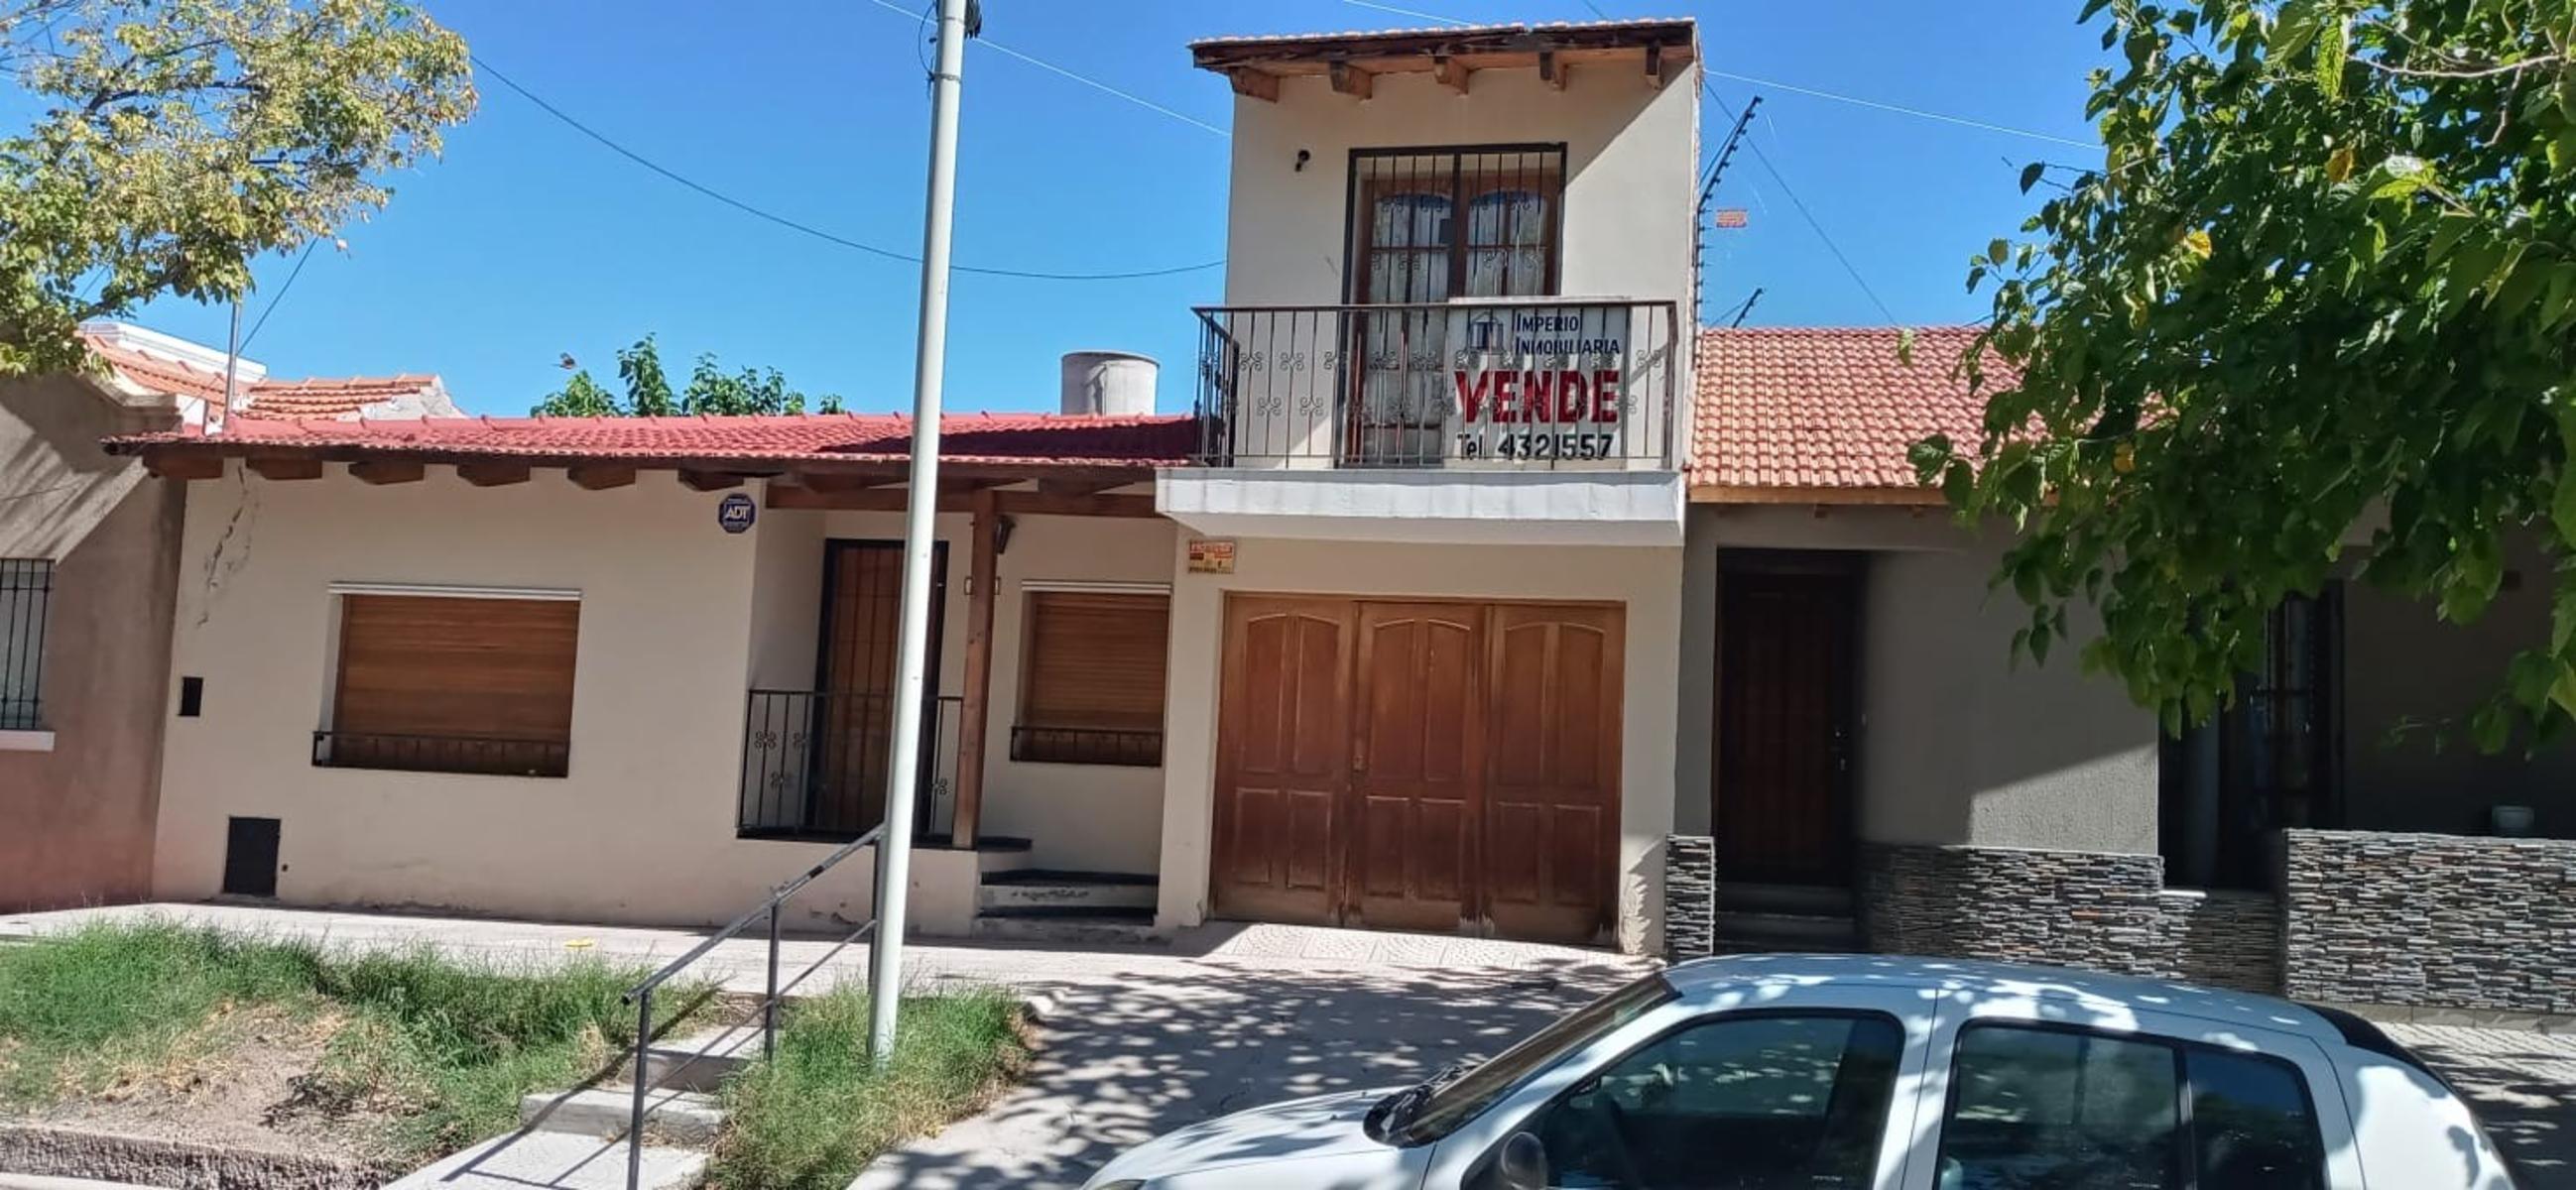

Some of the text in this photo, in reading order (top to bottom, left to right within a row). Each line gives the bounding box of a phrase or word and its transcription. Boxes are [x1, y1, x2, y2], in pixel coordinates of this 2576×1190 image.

[1516, 312, 1579, 332] IMPERIO
[1515, 337, 1620, 355] INMOBILIARIA
[1454, 370, 1620, 423] VENDE
[1498, 433, 1614, 460] 4321557
[724, 505, 751, 520] ADT
